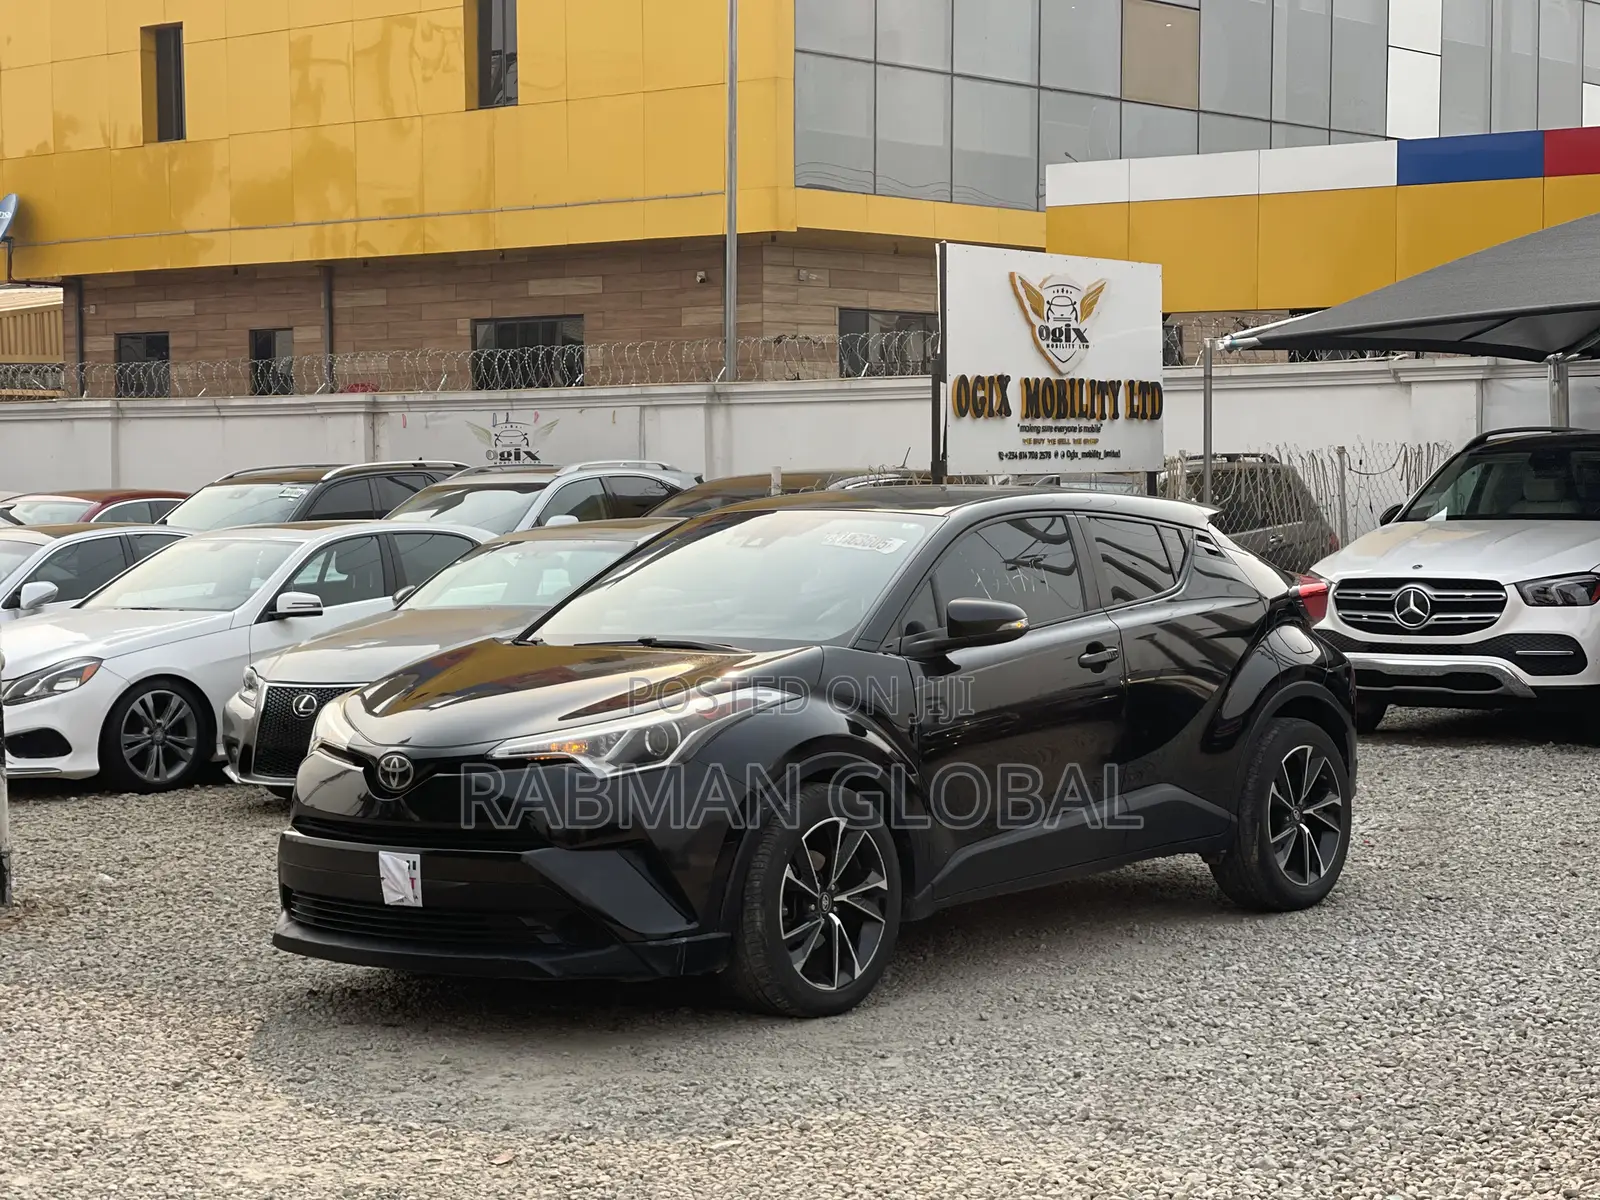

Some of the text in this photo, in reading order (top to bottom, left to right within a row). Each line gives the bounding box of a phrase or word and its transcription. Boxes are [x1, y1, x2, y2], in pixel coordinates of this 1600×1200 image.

[1038, 323, 1089, 343] Ogix
[952, 373, 1163, 421] OGIX MOBILITY LTD
